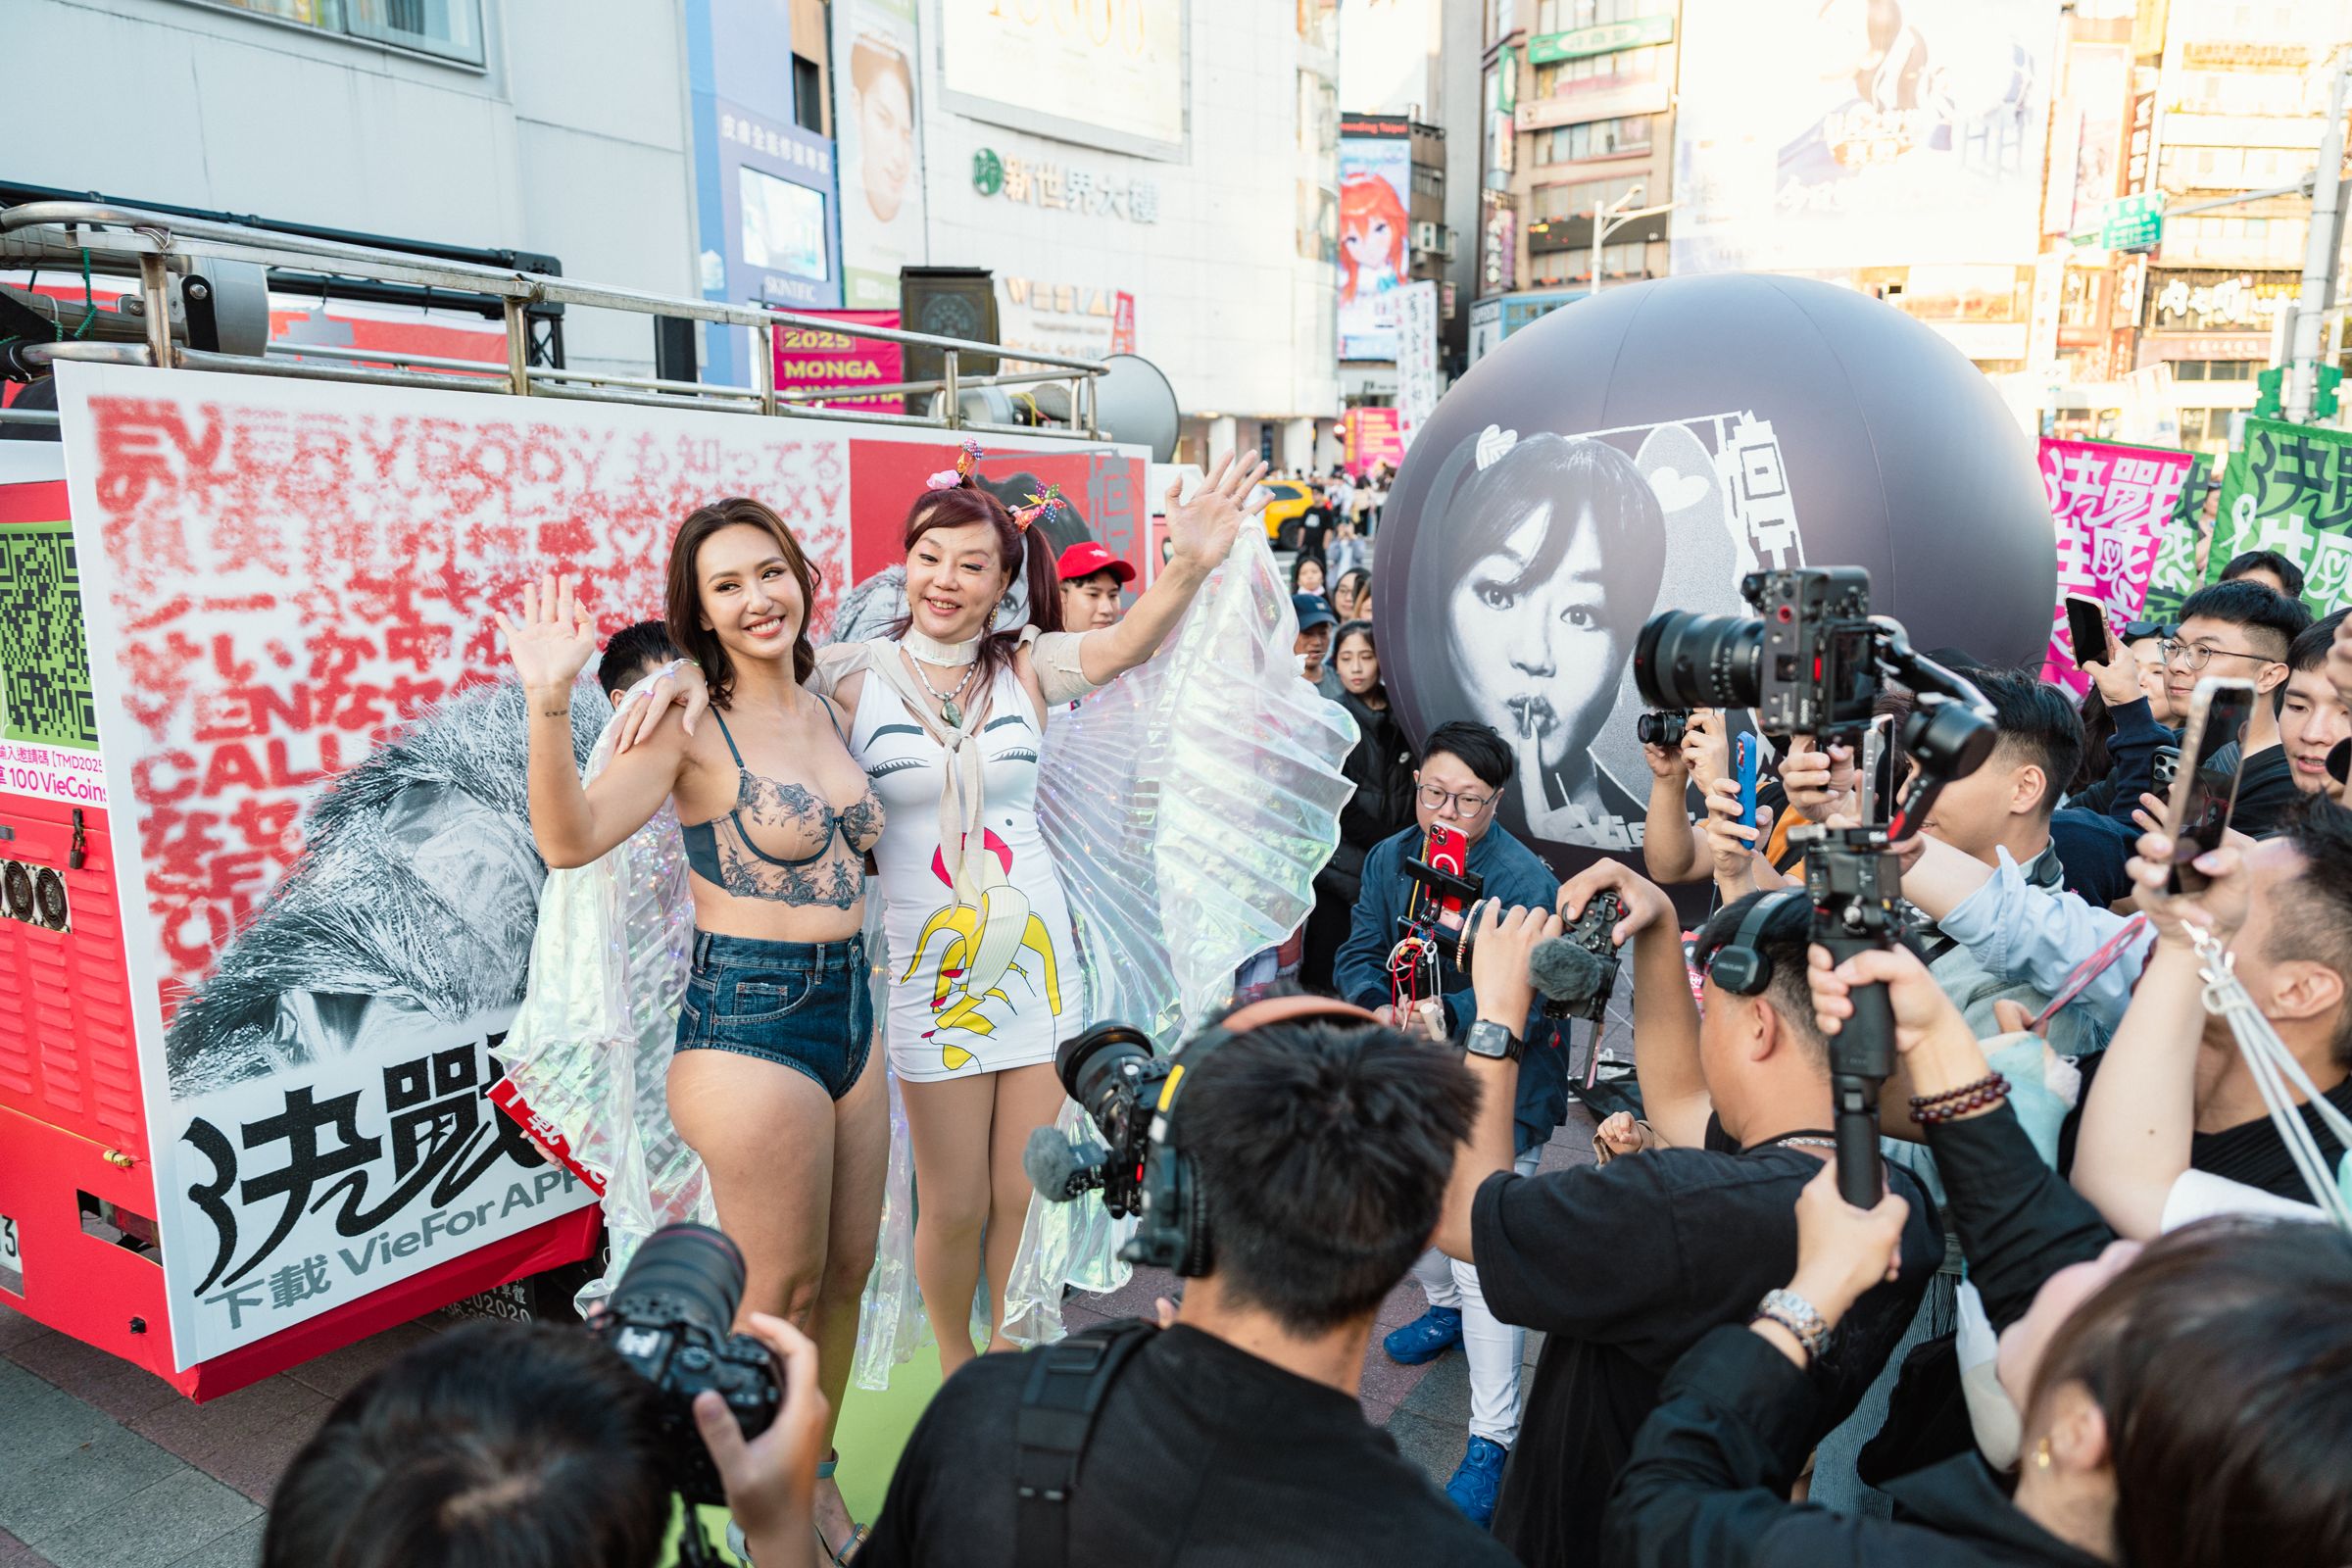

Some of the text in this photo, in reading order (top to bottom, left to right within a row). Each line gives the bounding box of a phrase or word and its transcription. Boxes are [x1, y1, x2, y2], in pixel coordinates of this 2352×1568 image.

[1004, 152, 1158, 225] 新世界大樓
[783, 360, 882, 380] MONGA
[784, 330, 852, 349] 2025
[2041, 447, 2191, 537] 決戰
[2251, 429, 2352, 531] 決
[9, 767, 39, 792] 100
[204, 1254, 332, 1330] 下載
[337, 1200, 496, 1276] VieFor
